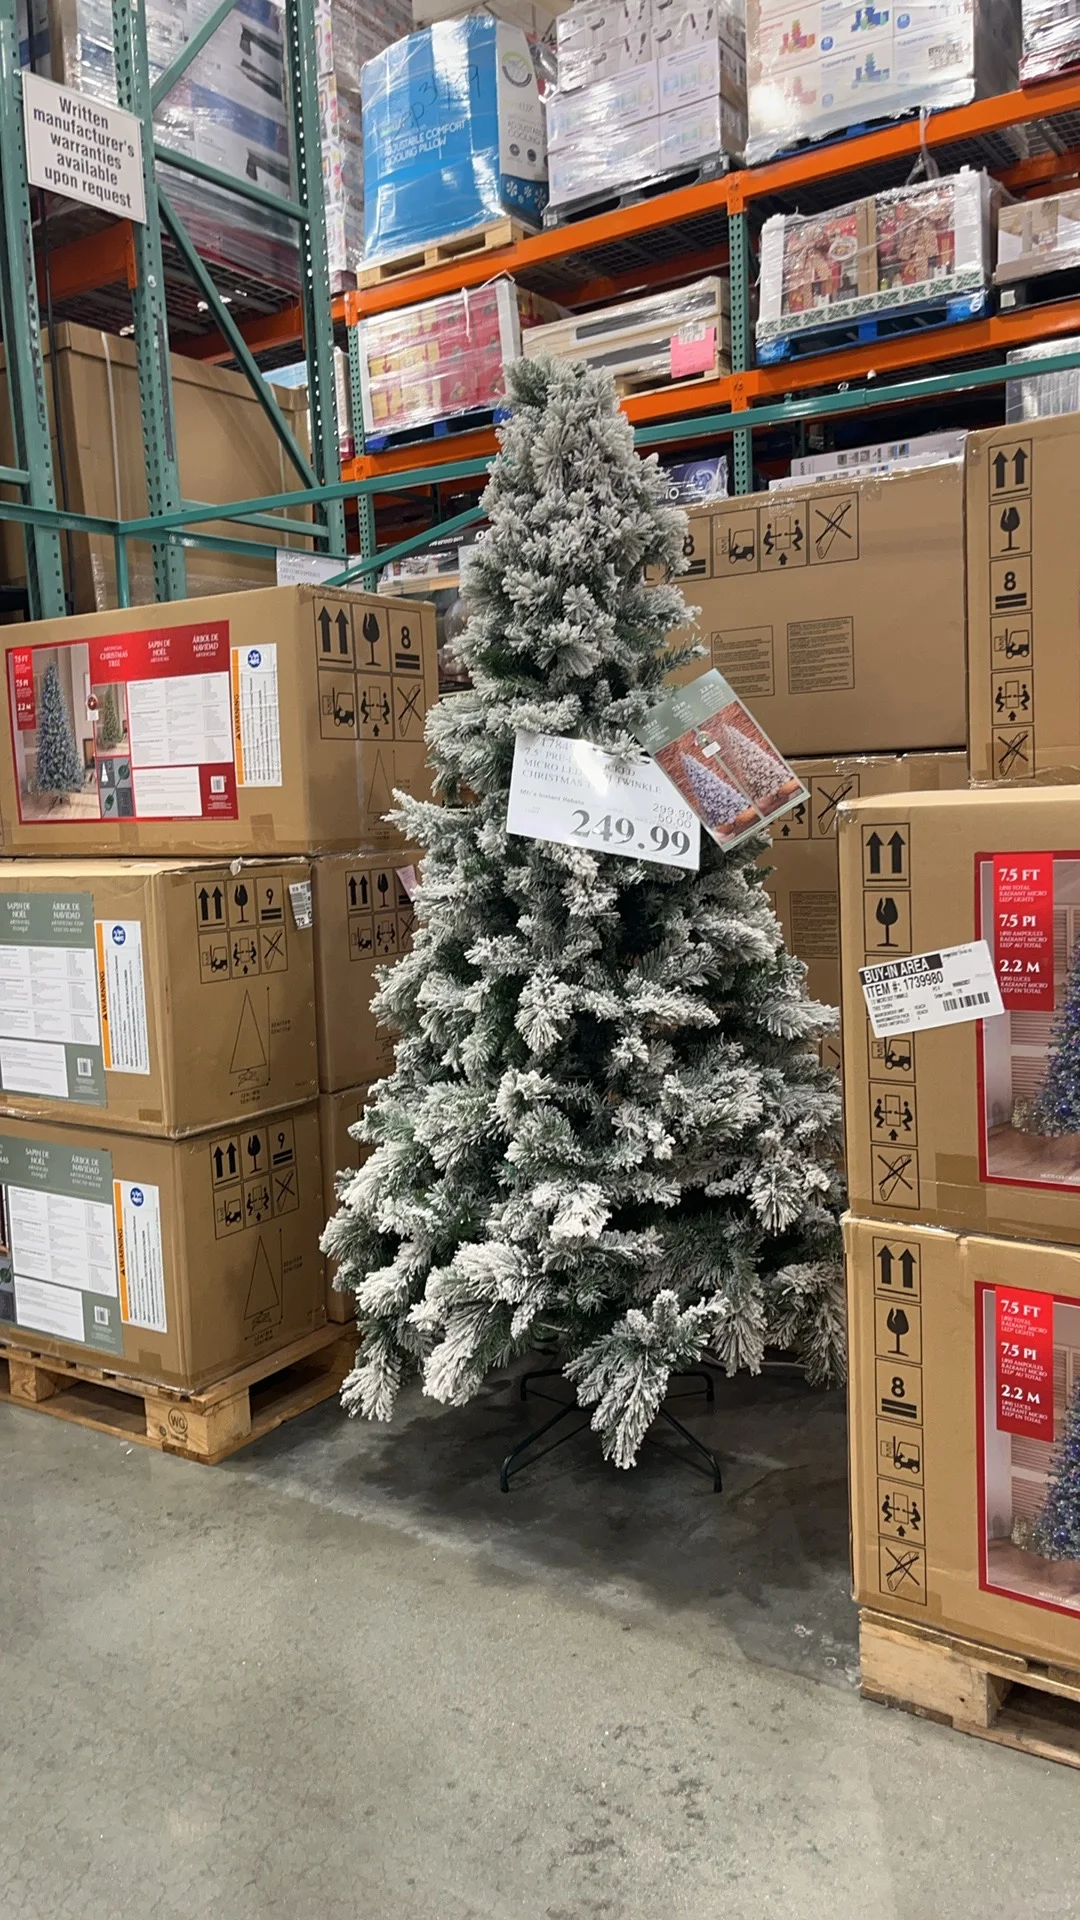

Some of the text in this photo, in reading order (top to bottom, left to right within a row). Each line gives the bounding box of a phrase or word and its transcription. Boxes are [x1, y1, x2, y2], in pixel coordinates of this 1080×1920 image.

[59, 96, 109, 130] Written
[33, 107, 135, 158] manufacturer's
[426, 119, 466, 140] COMFORT
[50, 132, 122, 170] warranties
[418, 135, 447, 154] PILLOW
[56, 153, 118, 186] available
[45, 166, 132, 208] upon request
[682, 534, 695, 556] 8
[1004, 571, 1016, 591] 8
[401, 626, 411, 649] 8
[193, 642, 219, 652] NAVIDAD
[522, 770, 583, 787] CHRISTMAS
[524, 759, 558, 771] MICRO
[617, 775, 662, 793] TWINKLE
[653, 803, 693, 820] 299.99
[571, 809, 691, 857] 249.99
[999, 868, 1041, 882] 7.5 FT
[266, 888, 274, 905] 9
[52, 901, 80, 911] ÁRBOL DE
[53, 911, 81, 919] NAVIDAD
[999, 914, 1036, 927] 7.5 PI
[863, 958, 930, 983] BUY-IN AREA
[999, 959, 1040, 973] 2.2 M
[99, 971, 107, 1013] WARNING
[866, 983, 891, 998] ITEM
[903, 971, 944, 991] 1739980
[277, 1132, 285, 1149] 9
[71, 1155, 100, 1167] ÁRBOL DE
[72, 1164, 100, 1175] NAVIDAD
[1000, 1299, 1041, 1318] 7.5 FT
[1001, 1320, 1048, 1334] RADIANT MICRO
[1013, 1316, 1031, 1325] TOTAL
[1015, 1328, 1035, 1337] LIGHTS
[1000, 1342, 1036, 1360] 7.5 PI
[1001, 1363, 1048, 1377] RADIANT MICRO
[1013, 1360, 1044, 1371] AMPOULES
[1024, 1373, 1042, 1382] TOTAL
[891, 1376, 906, 1398] 8
[1001, 1384, 1041, 1404] 2.2 M
[1001, 1405, 1048, 1420] RADIANT MICRO
[1014, 1402, 1031, 1411] LUCES
[1024, 1415, 1042, 1424] TOTAL
